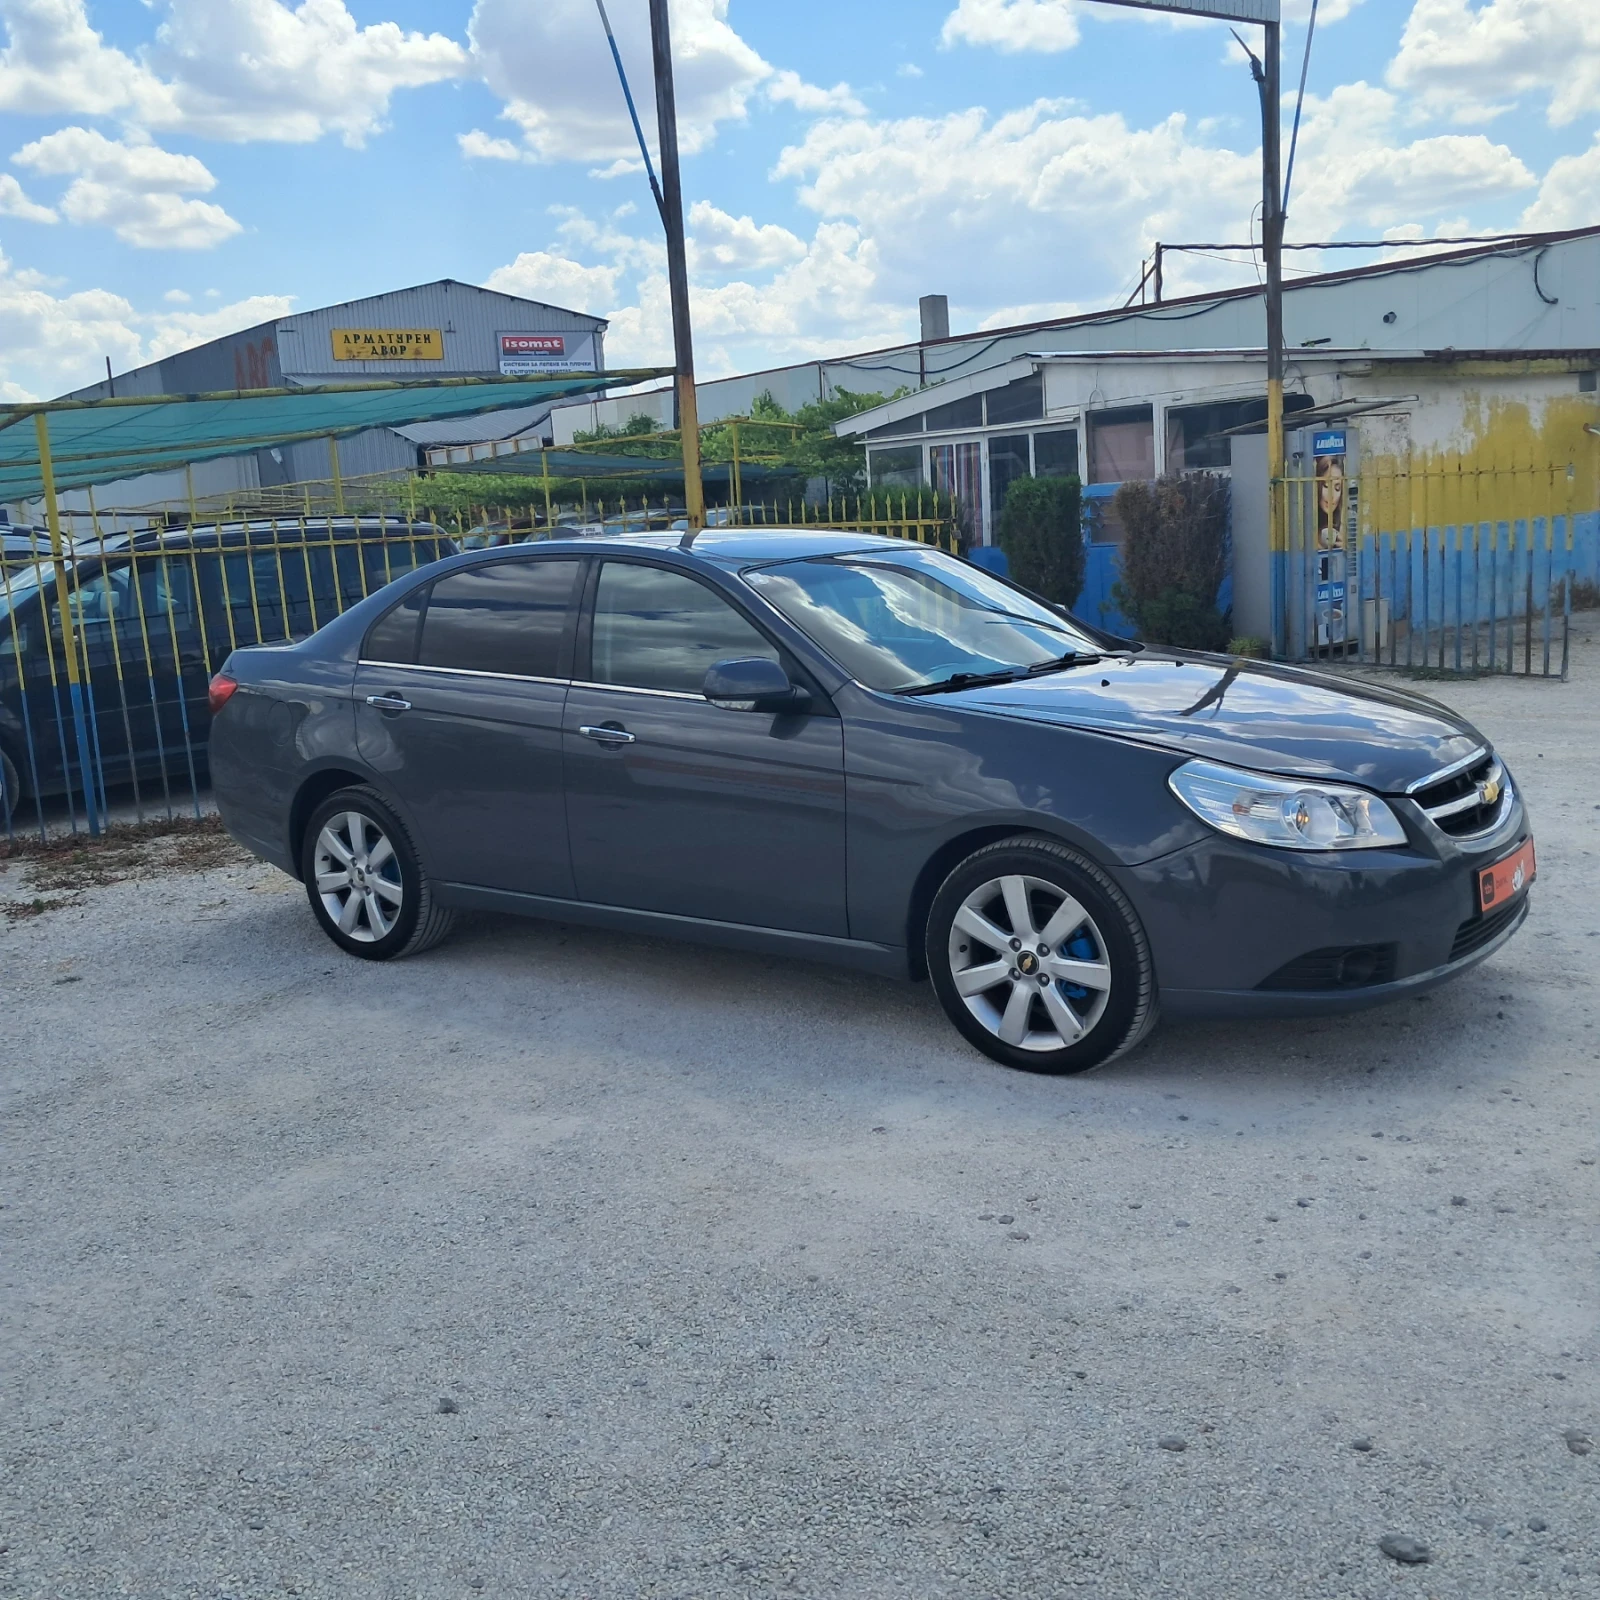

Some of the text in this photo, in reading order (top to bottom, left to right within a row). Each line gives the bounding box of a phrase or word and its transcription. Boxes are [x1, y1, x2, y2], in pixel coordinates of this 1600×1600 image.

[344, 334, 431, 344] АРМАТУРЕН
[505, 339, 561, 348] isomat
[371, 345, 407, 356] ДВОР
[1316, 435, 1344, 449] LAVAZZA
